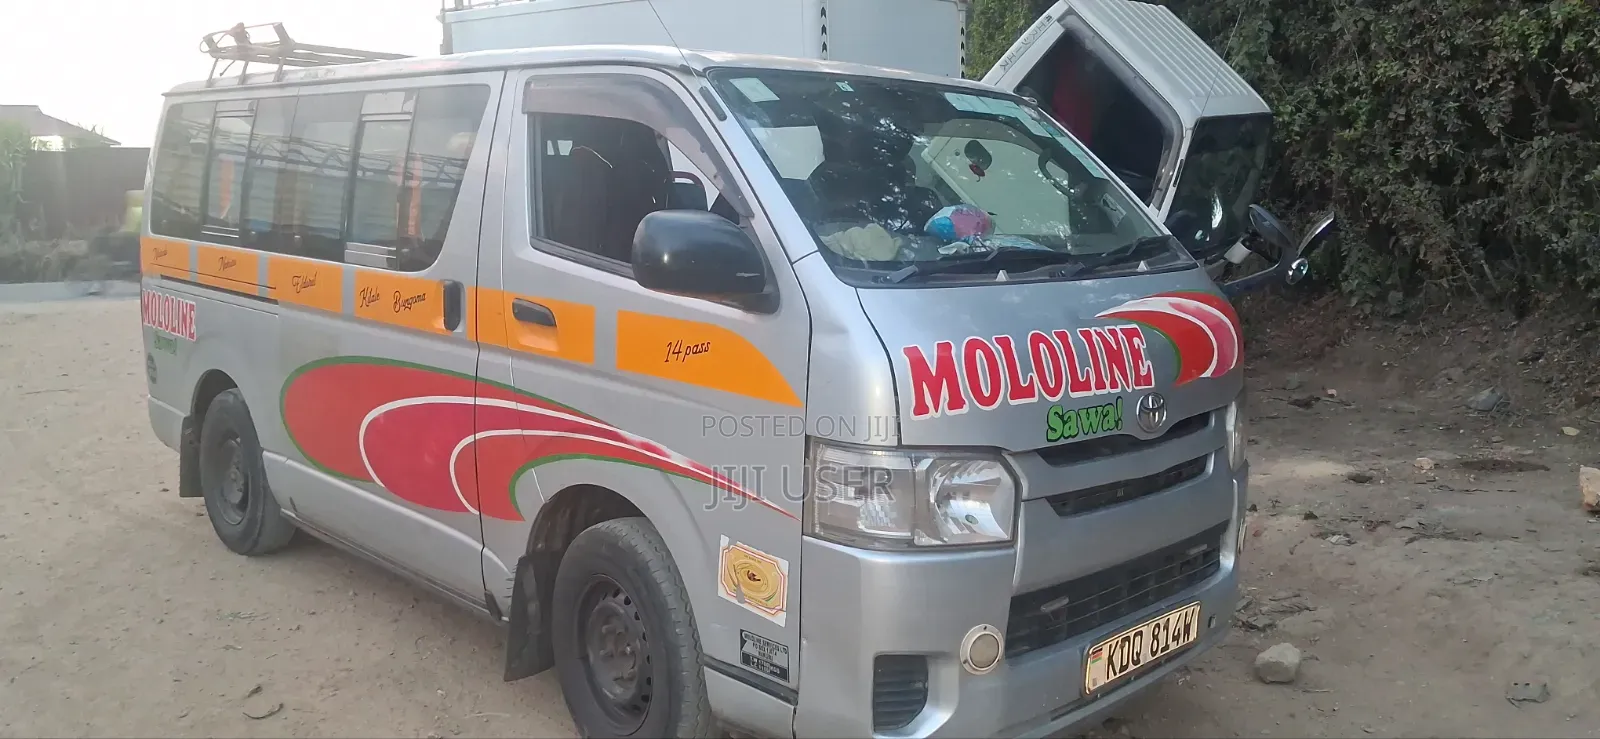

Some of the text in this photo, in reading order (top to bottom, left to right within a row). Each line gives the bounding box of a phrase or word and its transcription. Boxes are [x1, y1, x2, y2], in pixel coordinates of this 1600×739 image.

[142, 288, 196, 341] MOLOLINE
[393, 290, 426, 314] Bungoma
[682, 341, 711, 363] pass
[903, 324, 1155, 420] MOLOLINE
[1046, 396, 1123, 442] Sawa!
[1106, 607, 1195, 680] KDQ 814W
